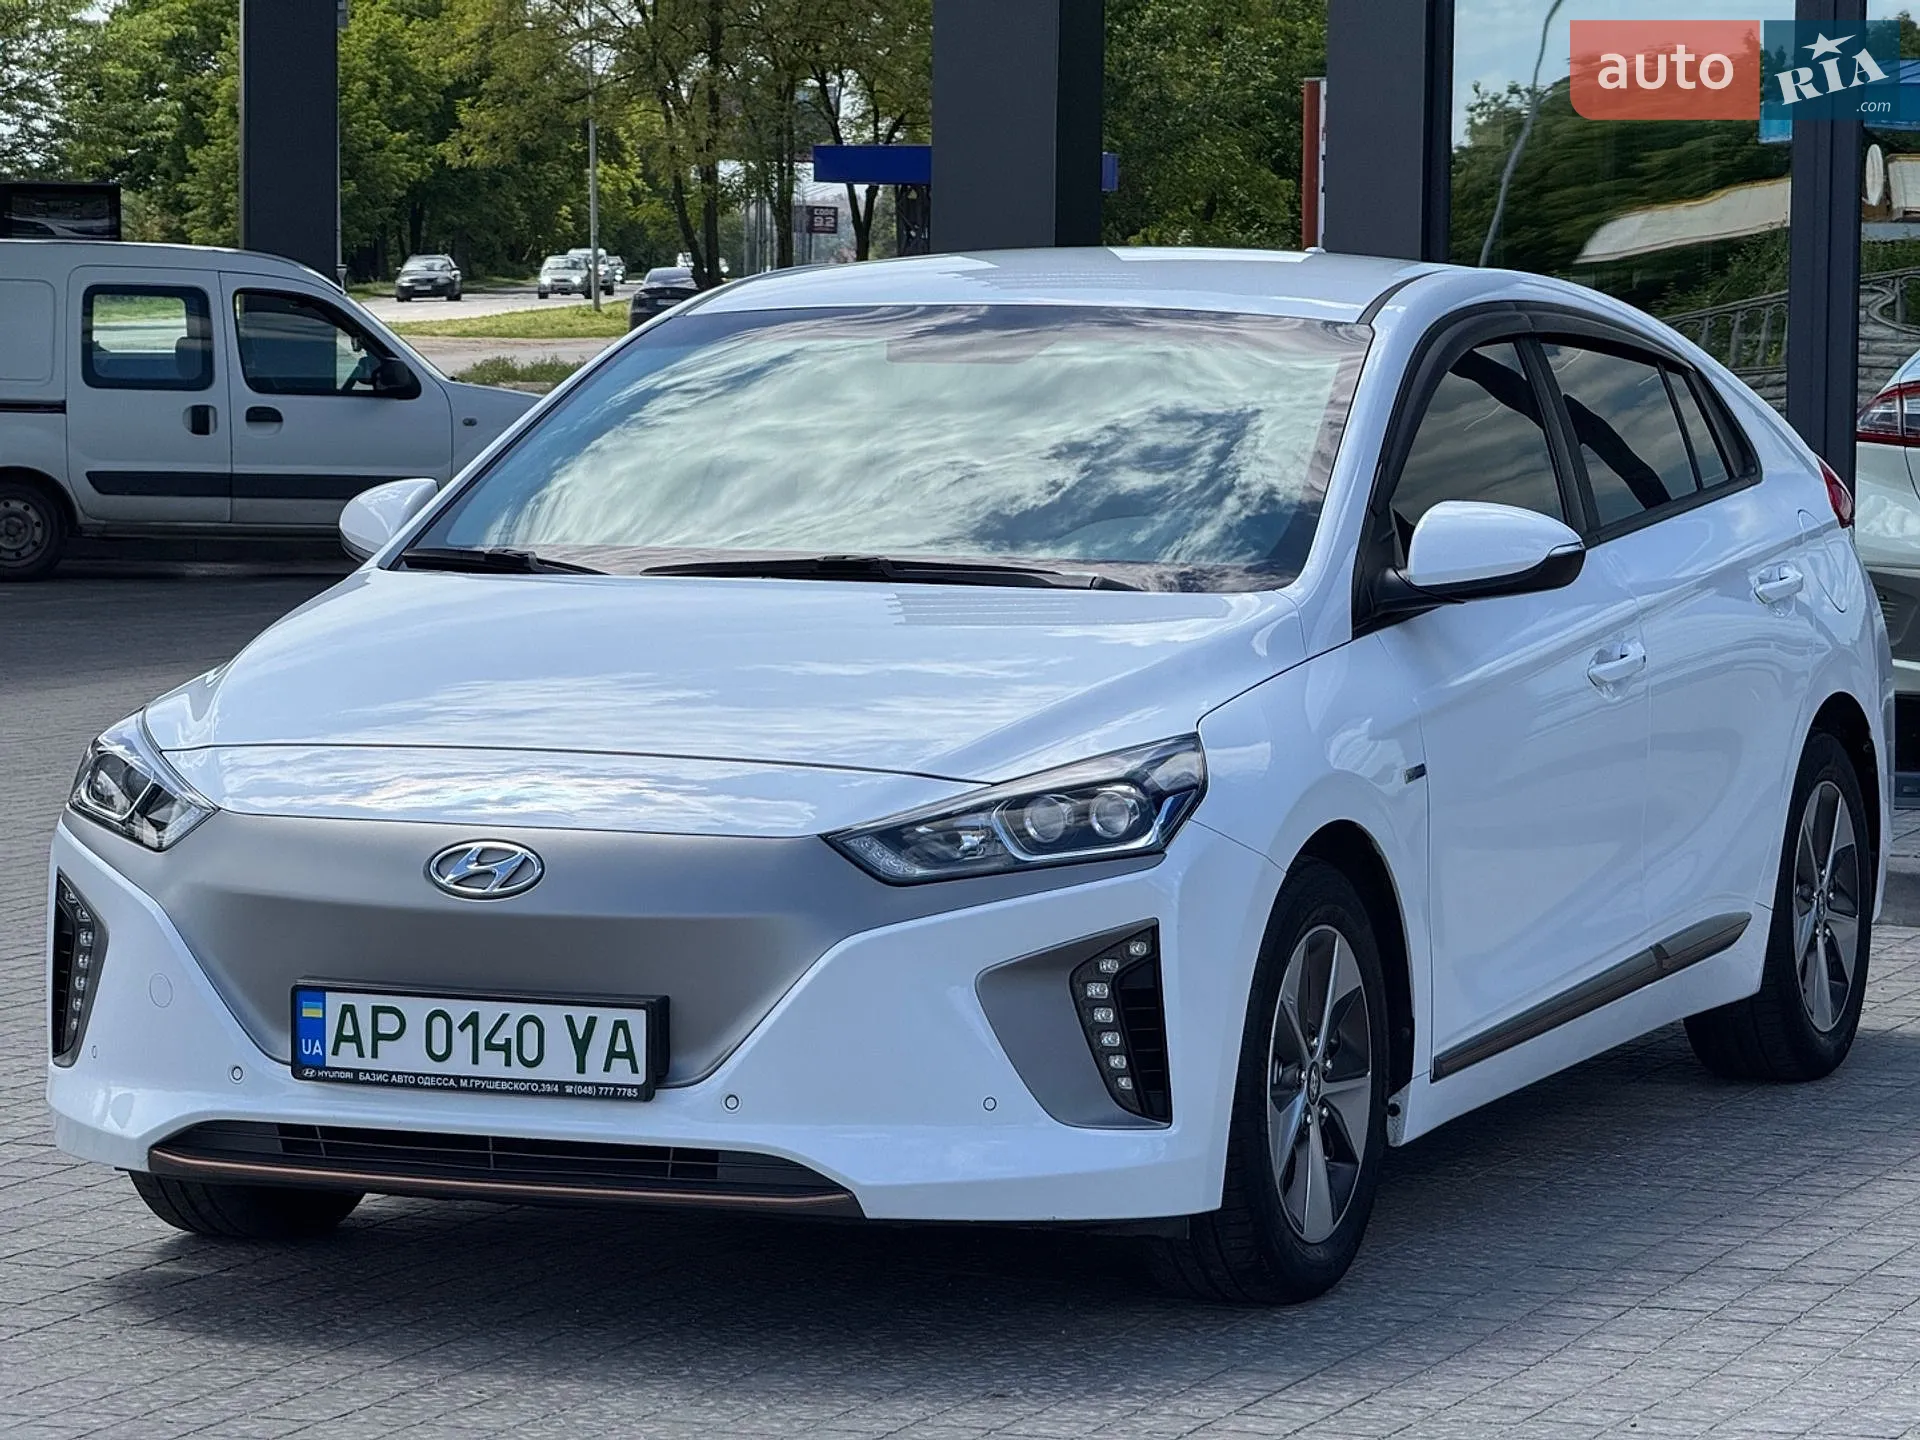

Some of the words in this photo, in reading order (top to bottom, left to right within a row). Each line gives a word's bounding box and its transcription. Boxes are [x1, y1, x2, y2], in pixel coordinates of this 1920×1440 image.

[331, 1004, 406, 1058] AP
[425, 1009, 545, 1068] 0140
[565, 1014, 639, 1074] YA
[302, 1039, 323, 1056] UA
[358, 1072, 388, 1083] БАЗИС
[390, 1074, 415, 1084] АВТО
[417, 1076, 458, 1088] ОДЕССА,
[598, 1086, 615, 1095] 777
